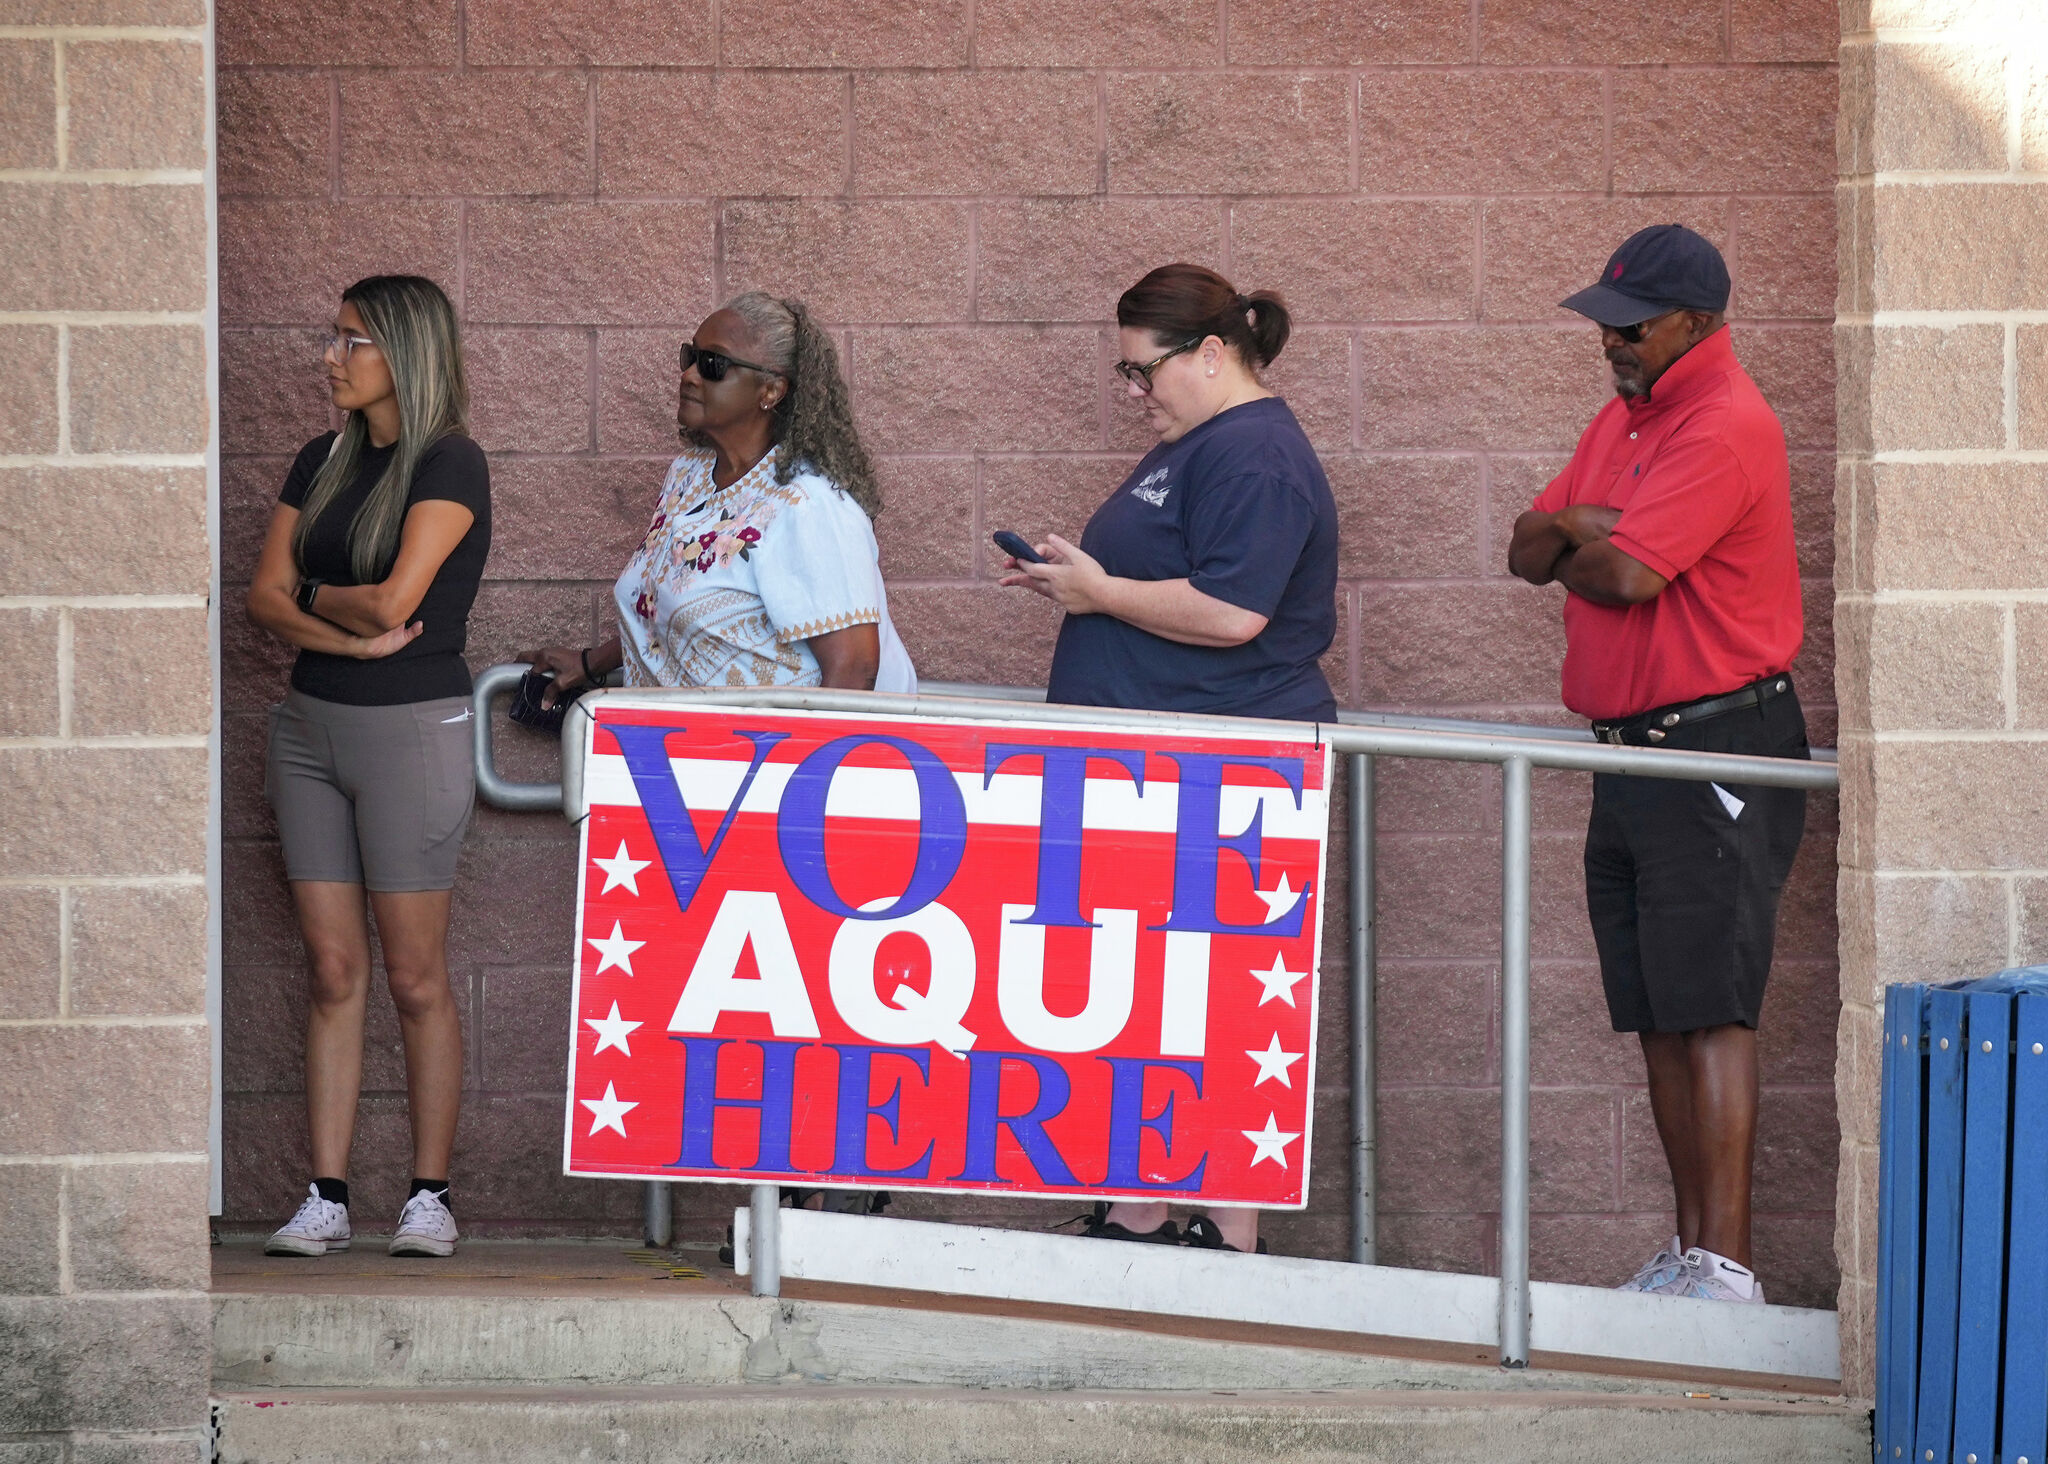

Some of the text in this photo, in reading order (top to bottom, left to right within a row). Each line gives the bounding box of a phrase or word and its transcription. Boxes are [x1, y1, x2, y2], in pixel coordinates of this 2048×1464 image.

[600, 724, 1310, 938] VOTE
[666, 890, 1212, 1061] AQUI
[662, 1036, 1209, 1191] HERE
